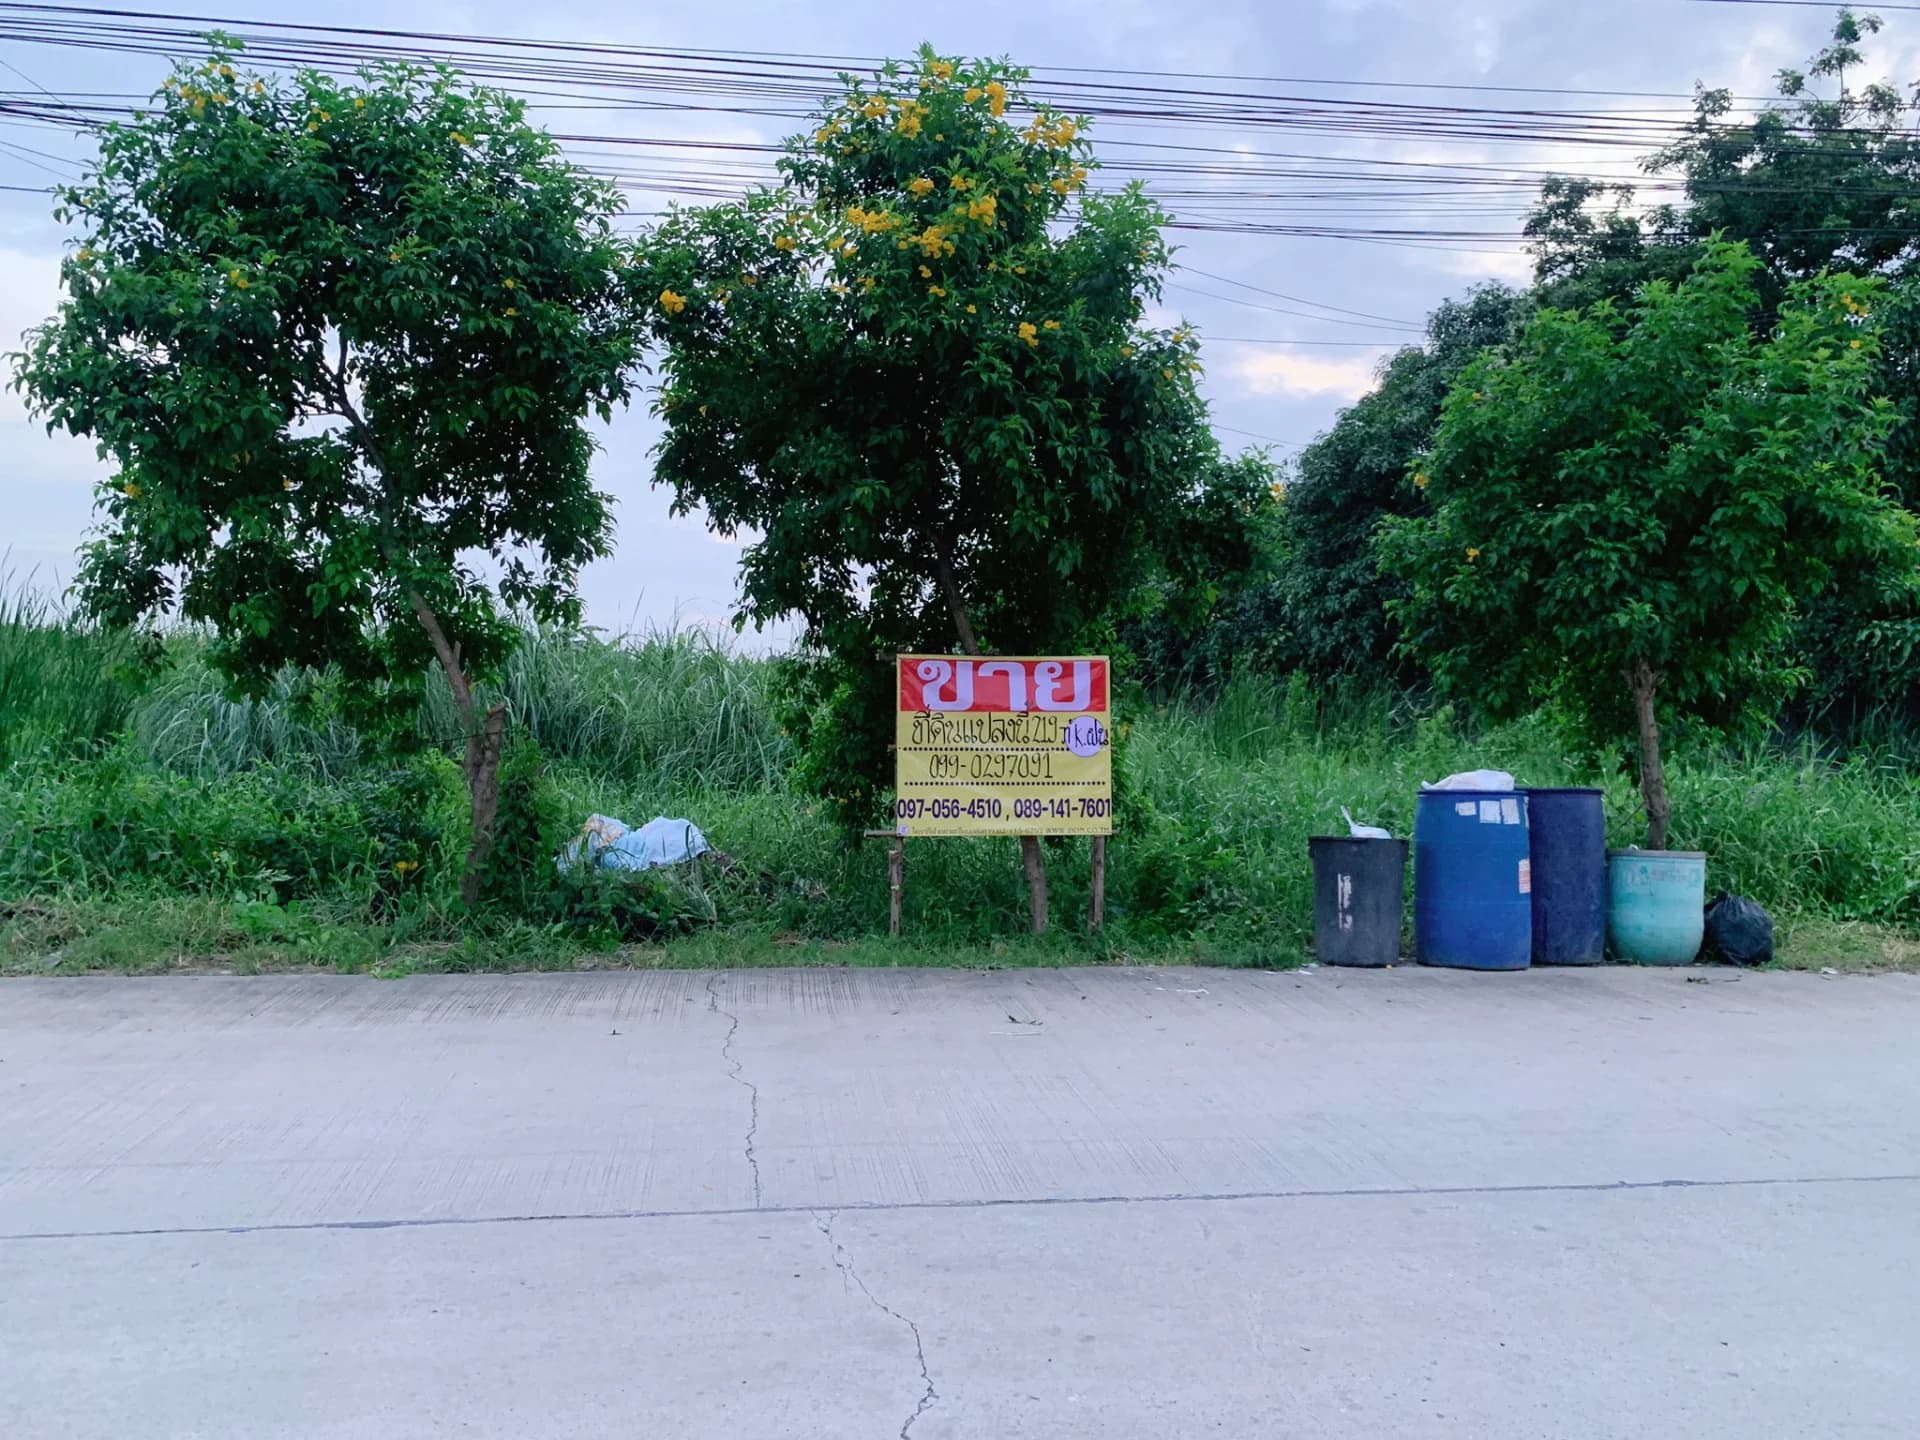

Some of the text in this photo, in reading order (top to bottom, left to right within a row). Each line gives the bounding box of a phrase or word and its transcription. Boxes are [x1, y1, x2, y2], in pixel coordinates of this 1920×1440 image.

[917, 660, 1092, 711] ขาย
[912, 703, 1030, 745] ที่ดินแปลงนี้
[1014, 798, 1112, 818] 089-141-7601
